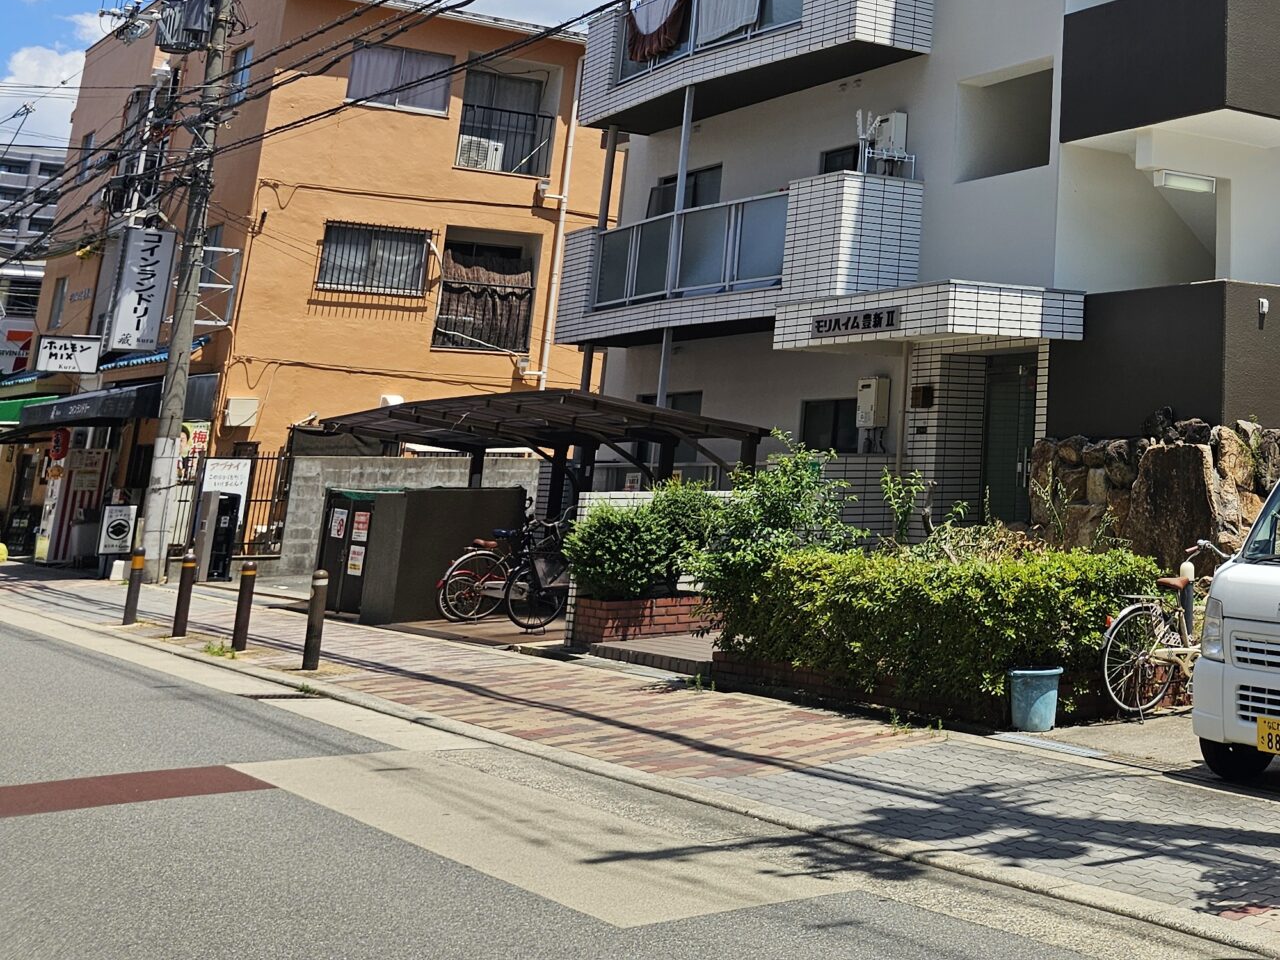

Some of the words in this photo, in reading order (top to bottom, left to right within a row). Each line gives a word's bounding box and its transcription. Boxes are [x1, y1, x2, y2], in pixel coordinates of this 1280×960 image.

[133, 233, 163, 331] コインランドリー
[43, 341, 92, 353] ホルモン
[49, 352, 74, 360] MIX
